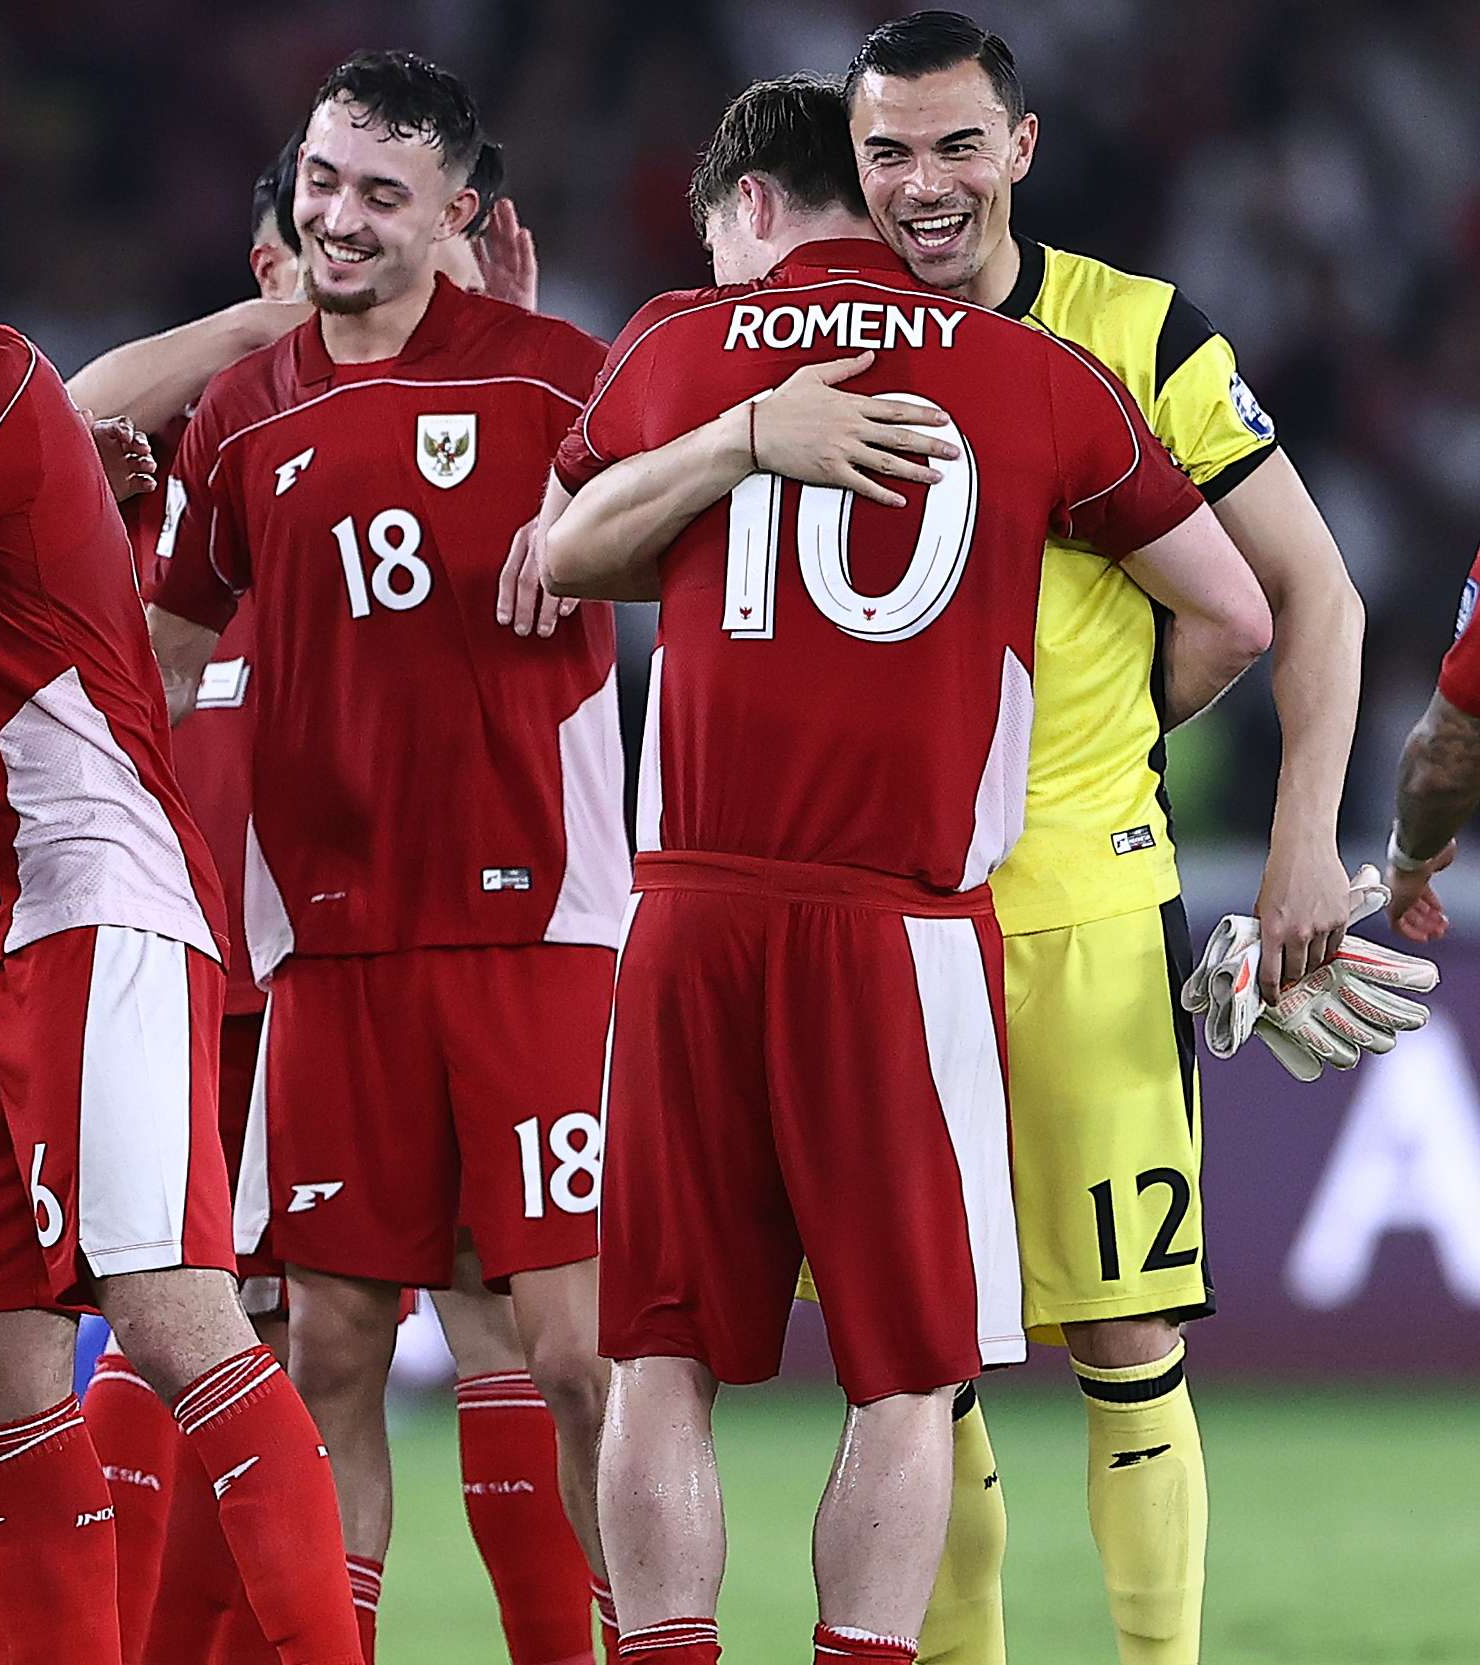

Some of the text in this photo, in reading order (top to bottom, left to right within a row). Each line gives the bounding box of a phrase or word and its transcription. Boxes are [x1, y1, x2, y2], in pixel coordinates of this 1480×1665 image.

[724, 301, 968, 351] ROMENY
[330, 508, 432, 619] 18
[720, 388, 979, 643] 10
[30, 1143, 63, 1248] 6
[513, 1111, 601, 1218] 18
[1087, 1167, 1199, 1281] 12
